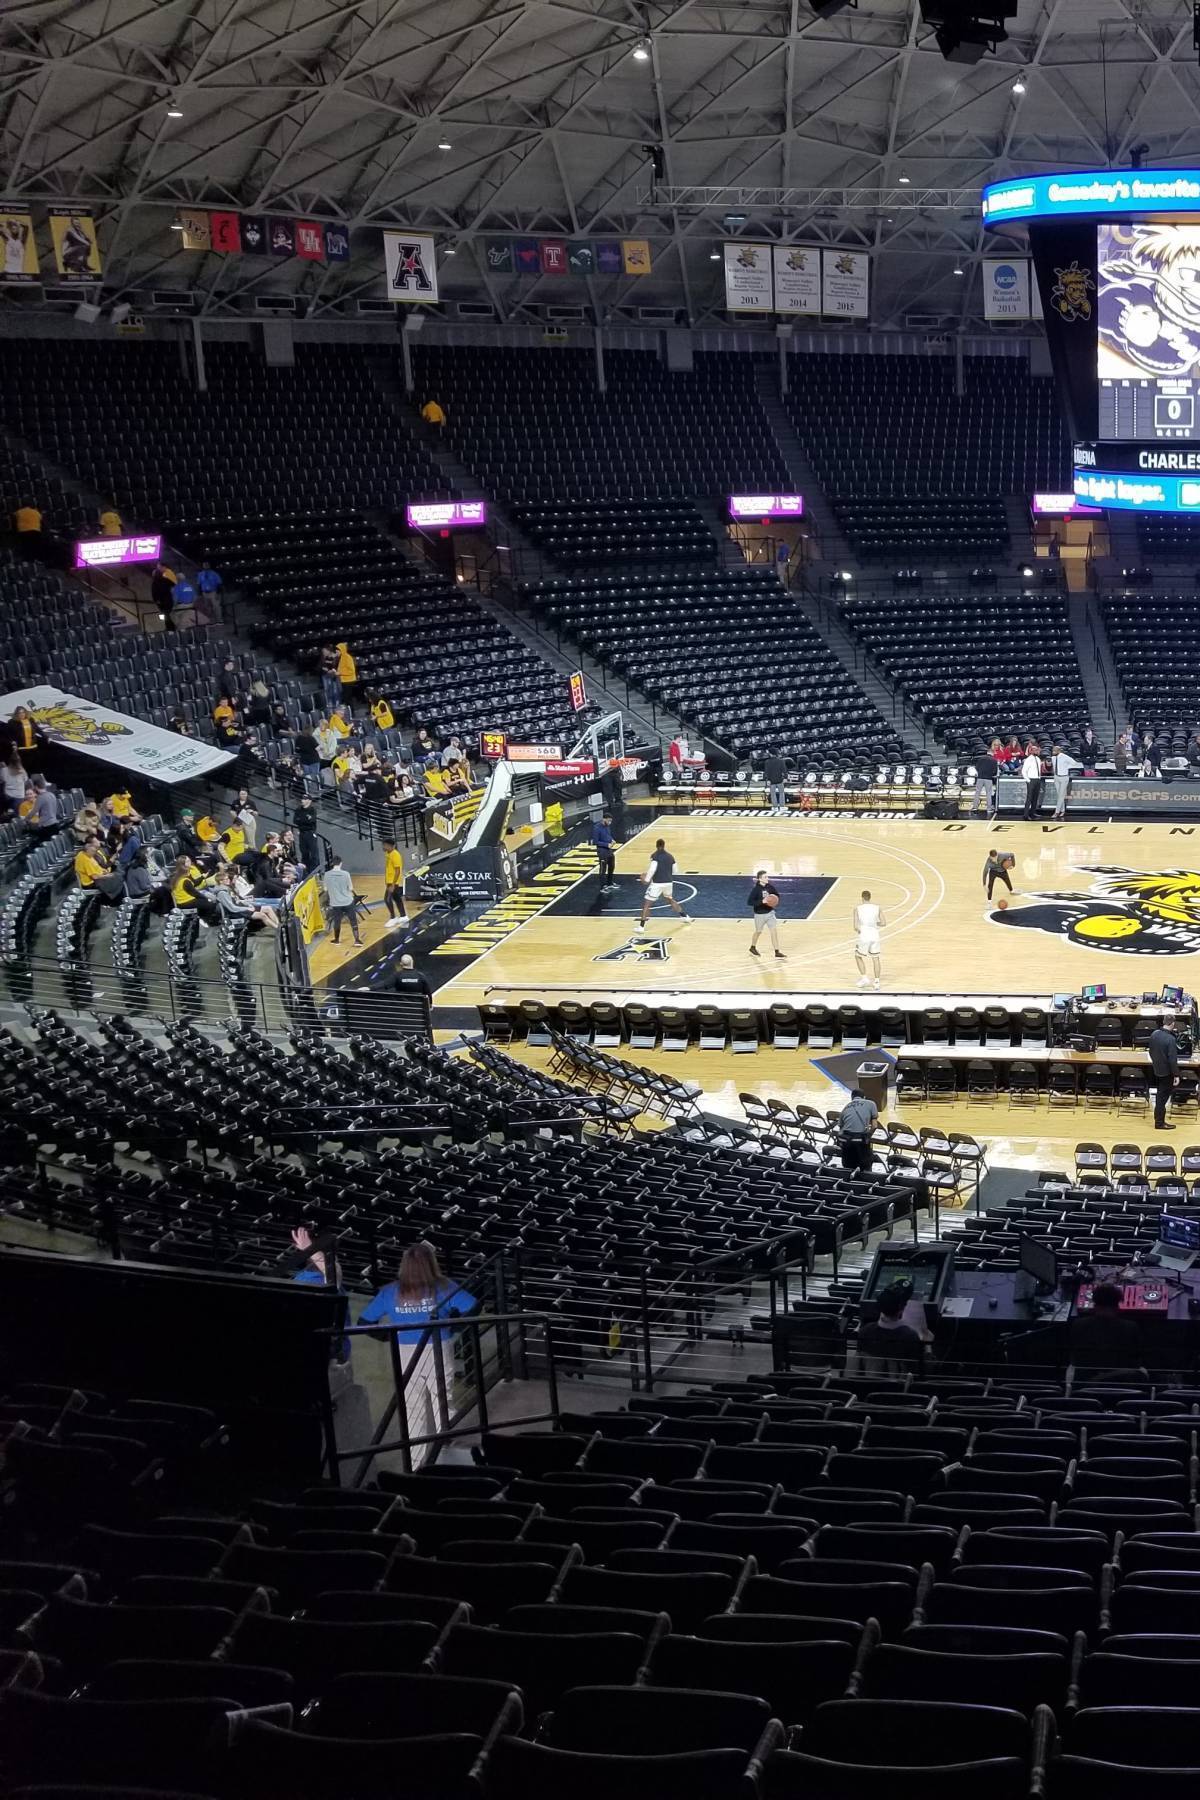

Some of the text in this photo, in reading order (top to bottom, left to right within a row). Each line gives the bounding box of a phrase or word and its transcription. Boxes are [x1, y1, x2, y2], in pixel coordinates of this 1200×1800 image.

[1132, 179, 1200, 199] favorite
[1167, 400, 1181, 420] 0
[487, 744, 500, 753] 23
[138, 748, 199, 770] Commerce
[467, 871, 492, 880] STAR
[429, 886, 570, 955] WICHITA
